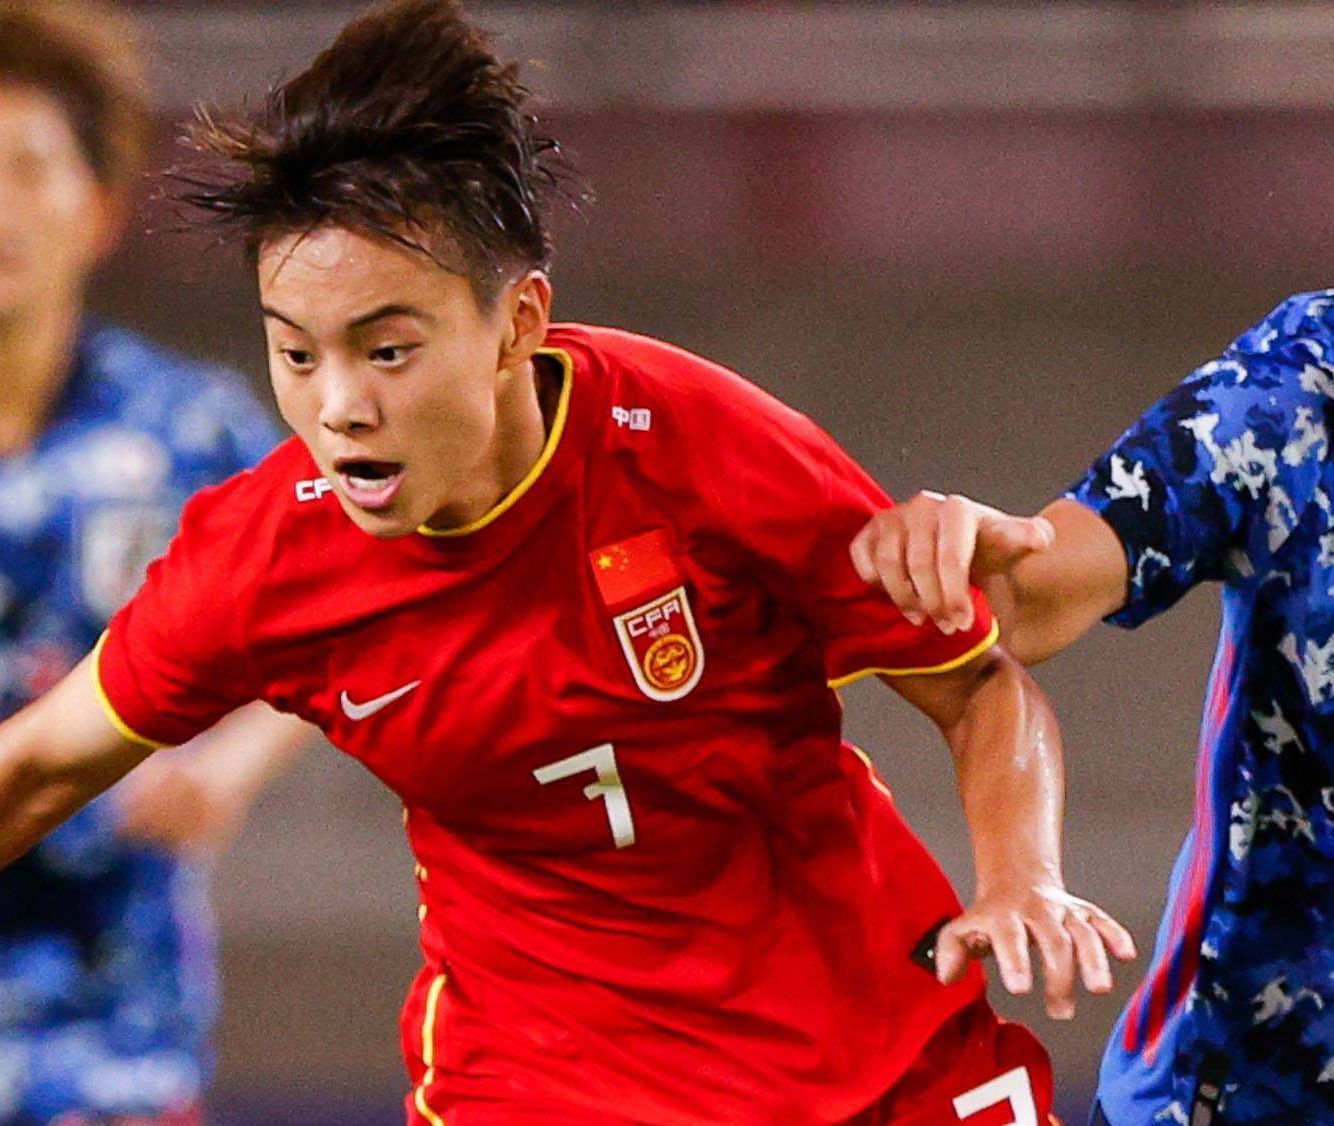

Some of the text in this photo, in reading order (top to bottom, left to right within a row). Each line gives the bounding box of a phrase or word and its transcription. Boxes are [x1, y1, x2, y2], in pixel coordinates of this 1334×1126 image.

[612, 405, 651, 431] 中国
[296, 478, 333, 502] CF
[627, 599, 681, 638] CFA
[532, 742, 636, 848] 7
